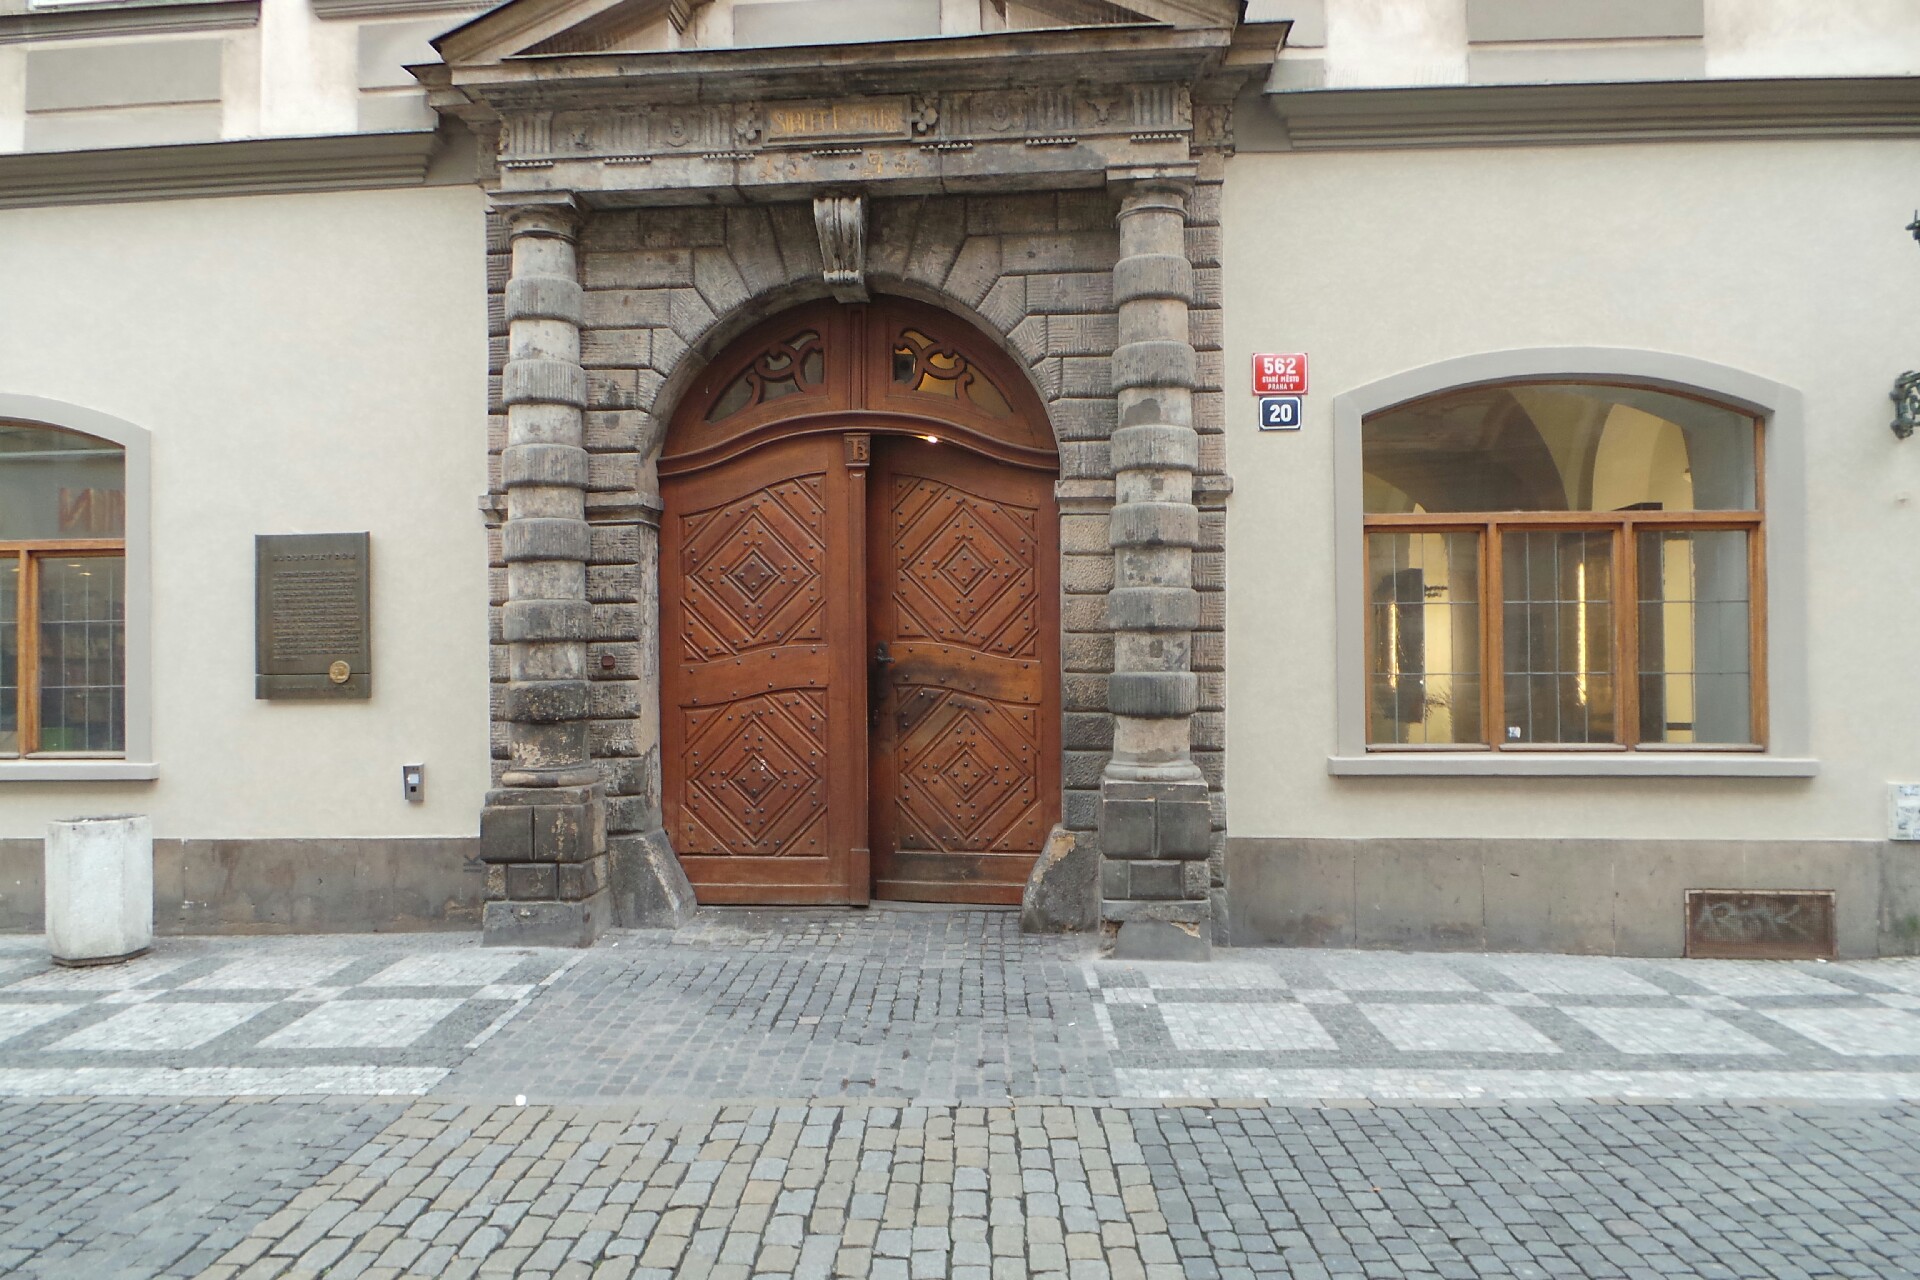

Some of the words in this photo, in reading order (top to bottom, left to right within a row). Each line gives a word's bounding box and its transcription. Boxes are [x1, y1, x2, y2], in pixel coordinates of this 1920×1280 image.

[1264, 358, 1297, 375] 562
[1262, 375, 1279, 383] STARÉ
[1280, 375, 1300, 383] MĚSTO
[1269, 404, 1292, 422] 20
